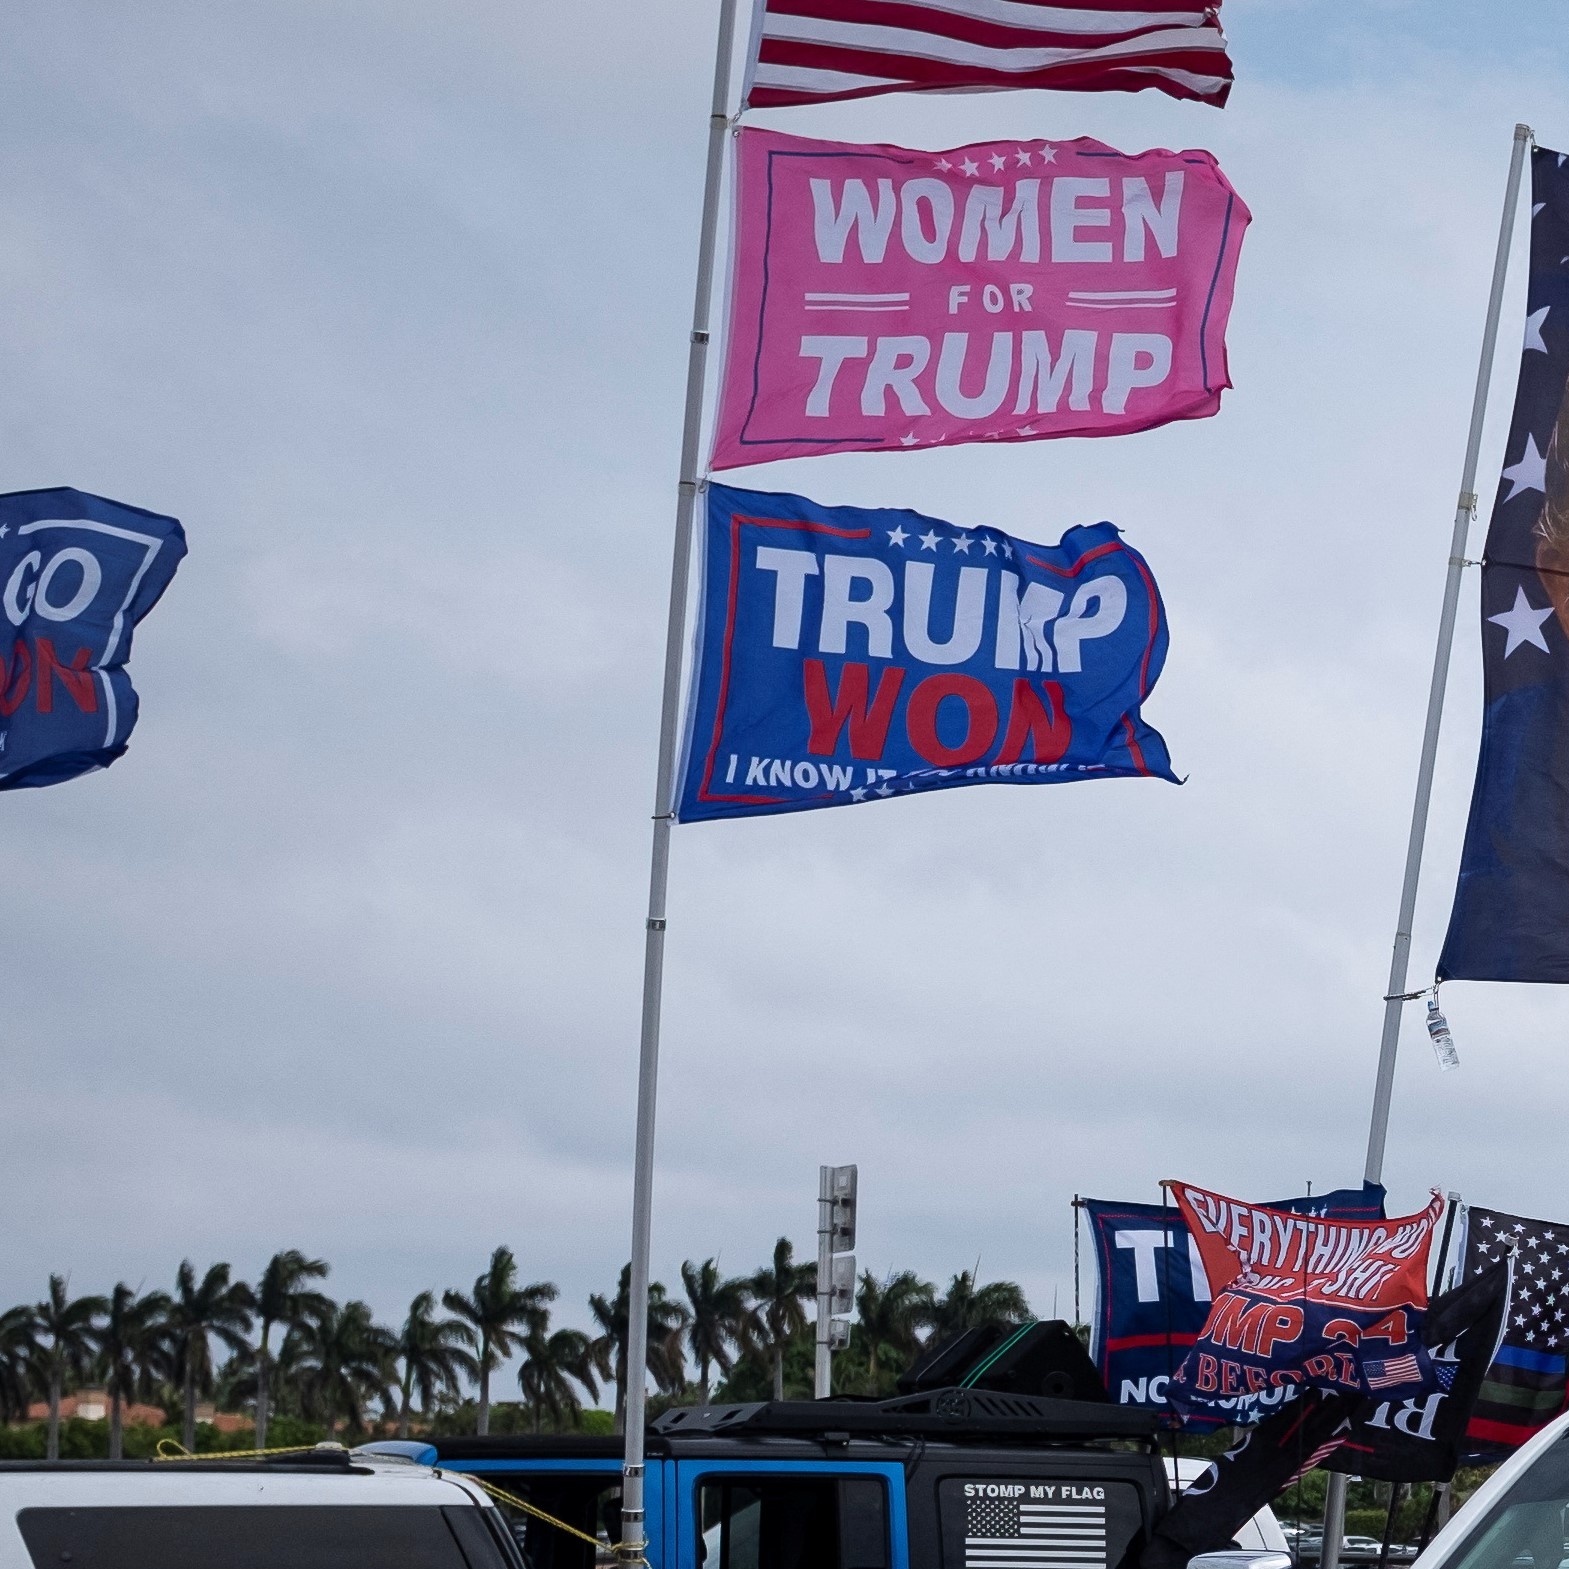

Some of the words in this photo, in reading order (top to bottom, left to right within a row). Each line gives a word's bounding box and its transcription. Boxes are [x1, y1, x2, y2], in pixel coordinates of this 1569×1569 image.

[808, 170, 1187, 264] WOMEN
[948, 283, 1034, 315] FOR
[799, 329, 1174, 420] TRUMP
[755, 545, 1128, 674] TRUMP
[803, 657, 1072, 768] WON
[725, 753, 740, 784] I
[744, 755, 853, 792] KNOW
[963, 1483, 1026, 1499] STOMP
[1029, 1485, 1056, 1499] MY
[1061, 1486, 1106, 1500] FLAG
